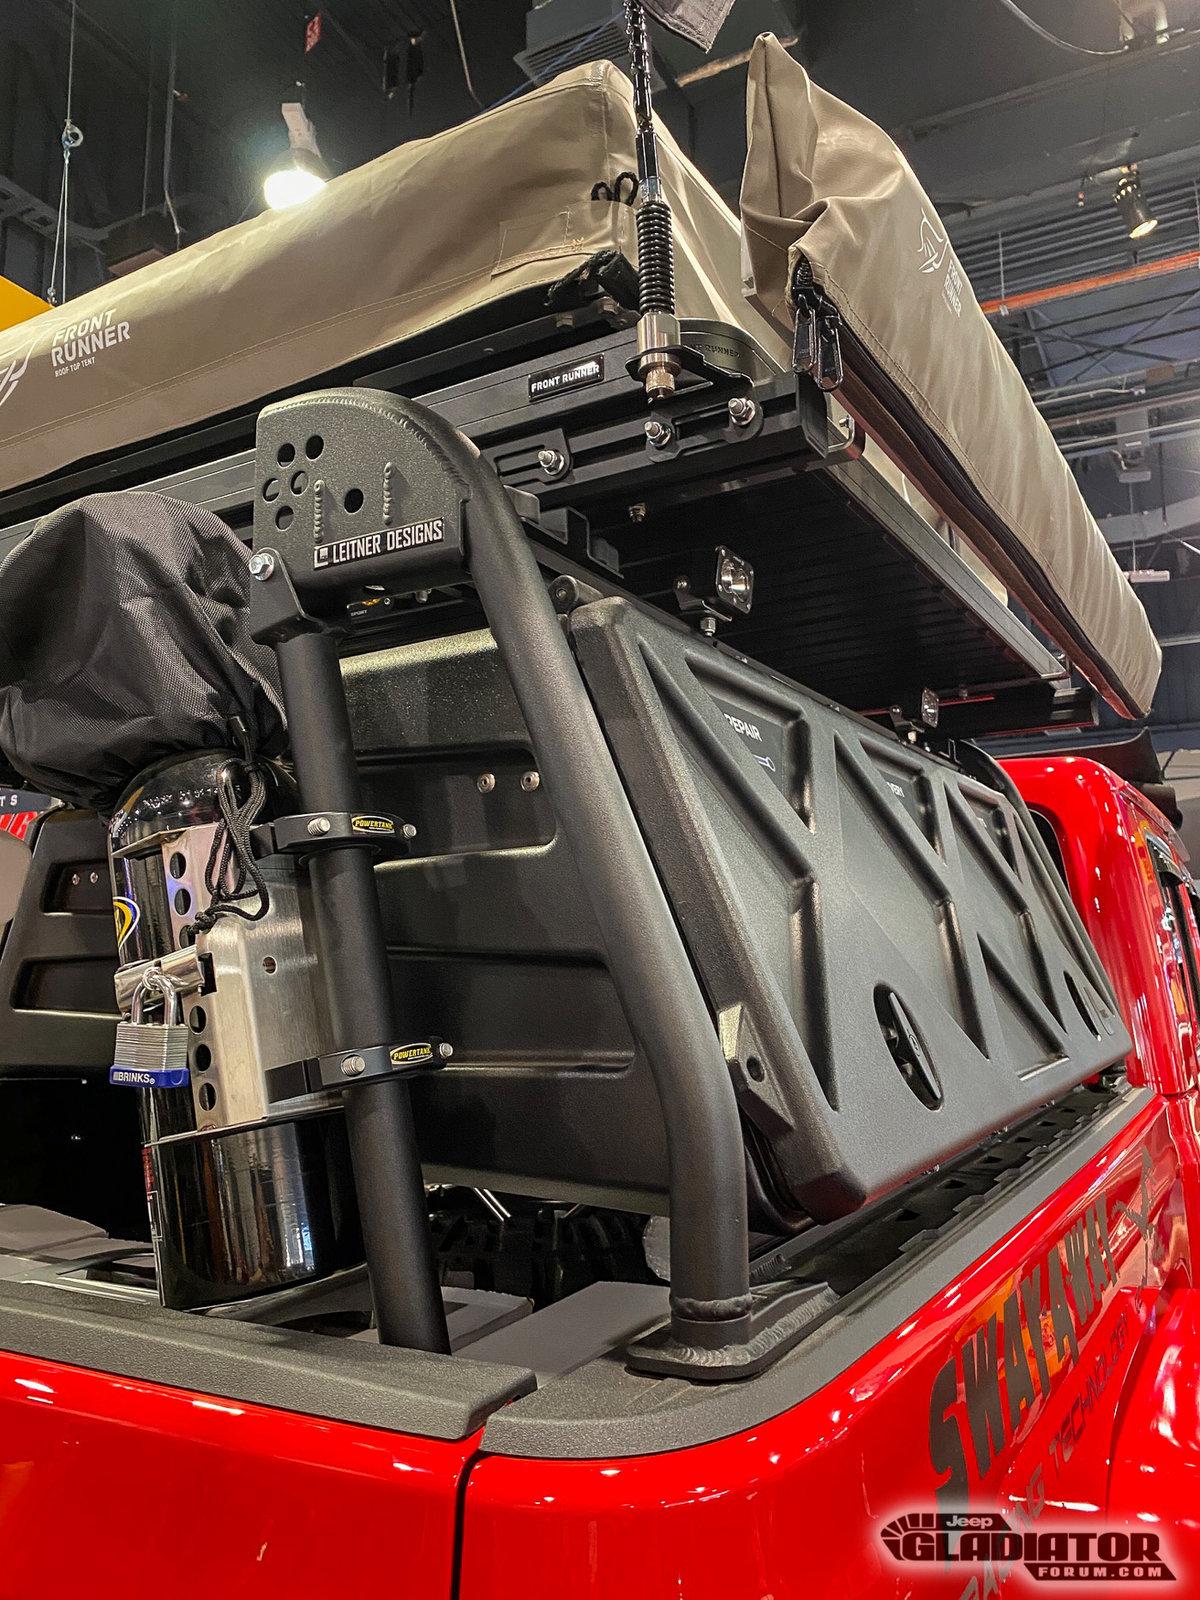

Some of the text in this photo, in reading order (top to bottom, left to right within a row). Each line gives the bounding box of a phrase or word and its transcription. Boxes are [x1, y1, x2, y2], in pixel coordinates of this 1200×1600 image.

[51, 321, 131, 367] RUNNER
[52, 308, 117, 347] FRONT
[54, 356, 96, 378] ROOF TOP TENT
[531, 364, 600, 393] FRONT RUNNER
[332, 519, 443, 564] LEITNER DESIGNS
